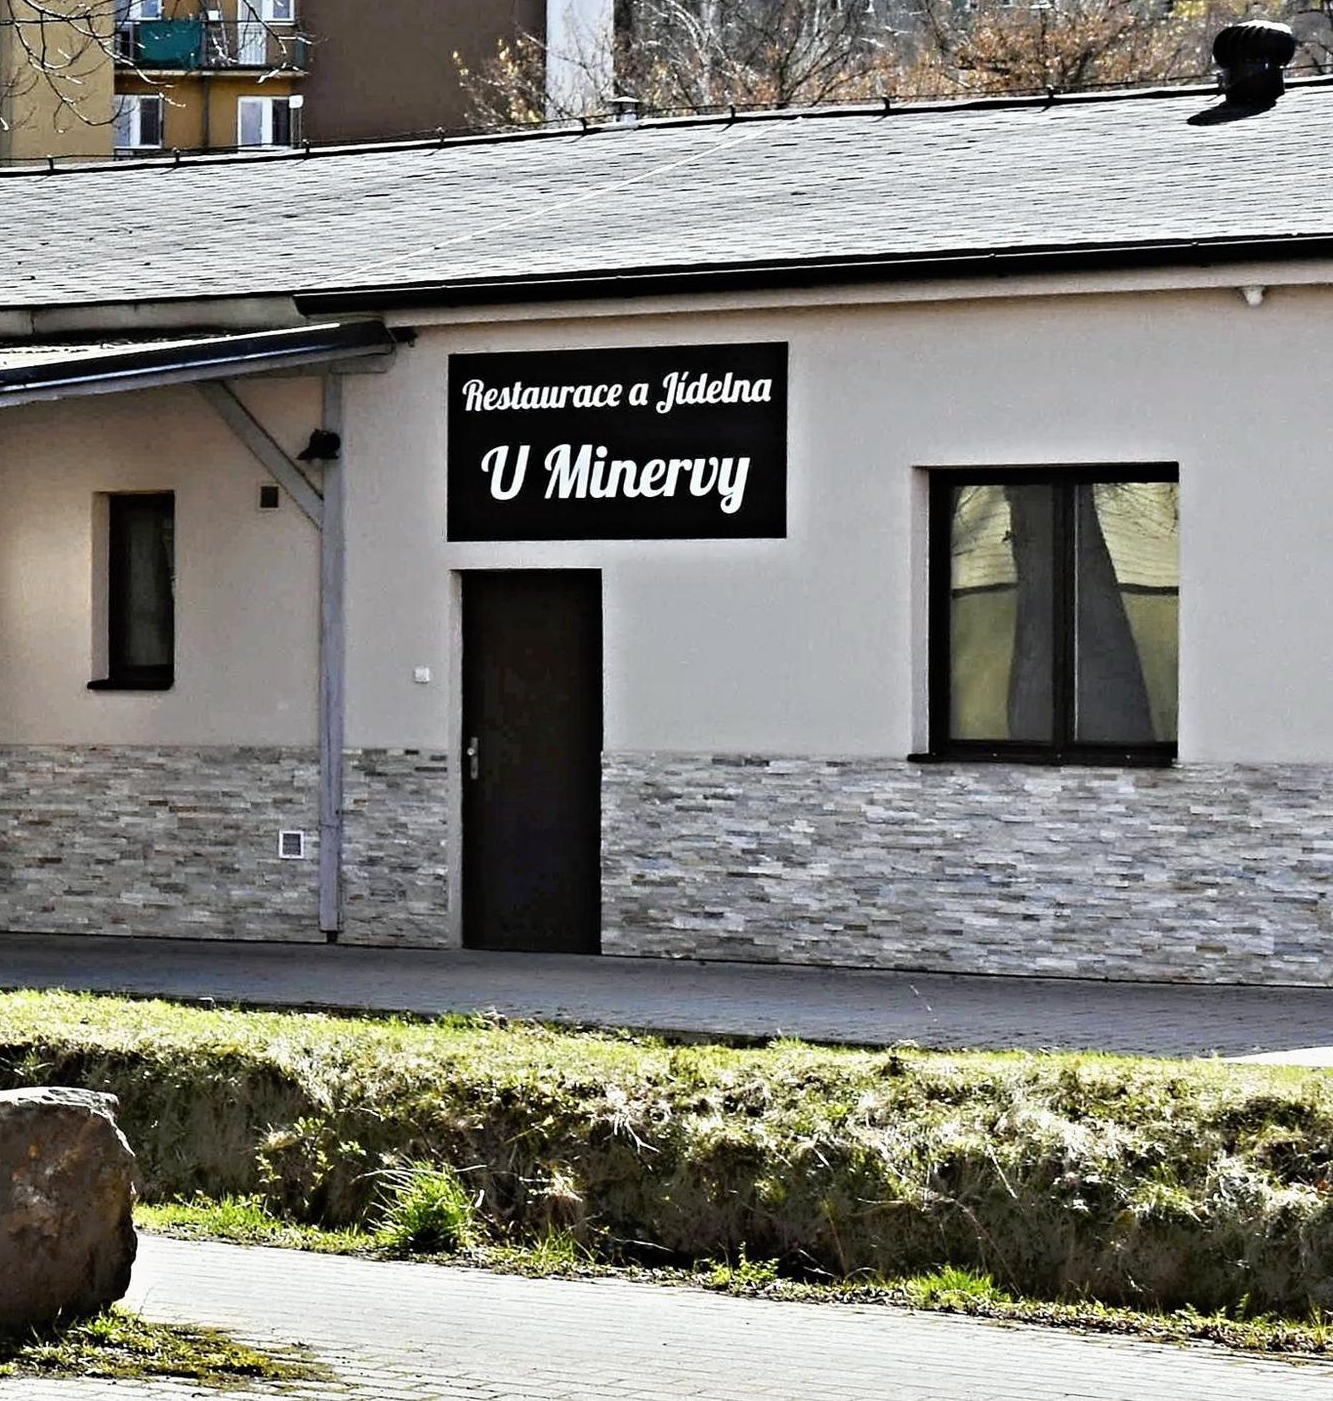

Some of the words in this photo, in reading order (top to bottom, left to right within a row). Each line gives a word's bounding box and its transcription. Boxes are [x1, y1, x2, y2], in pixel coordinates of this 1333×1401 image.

[462, 379, 623, 412] Restaurace
[629, 382, 649, 406] a
[656, 371, 773, 414] Jídelna
[481, 445, 531, 500] U
[544, 444, 751, 514] Minervy
